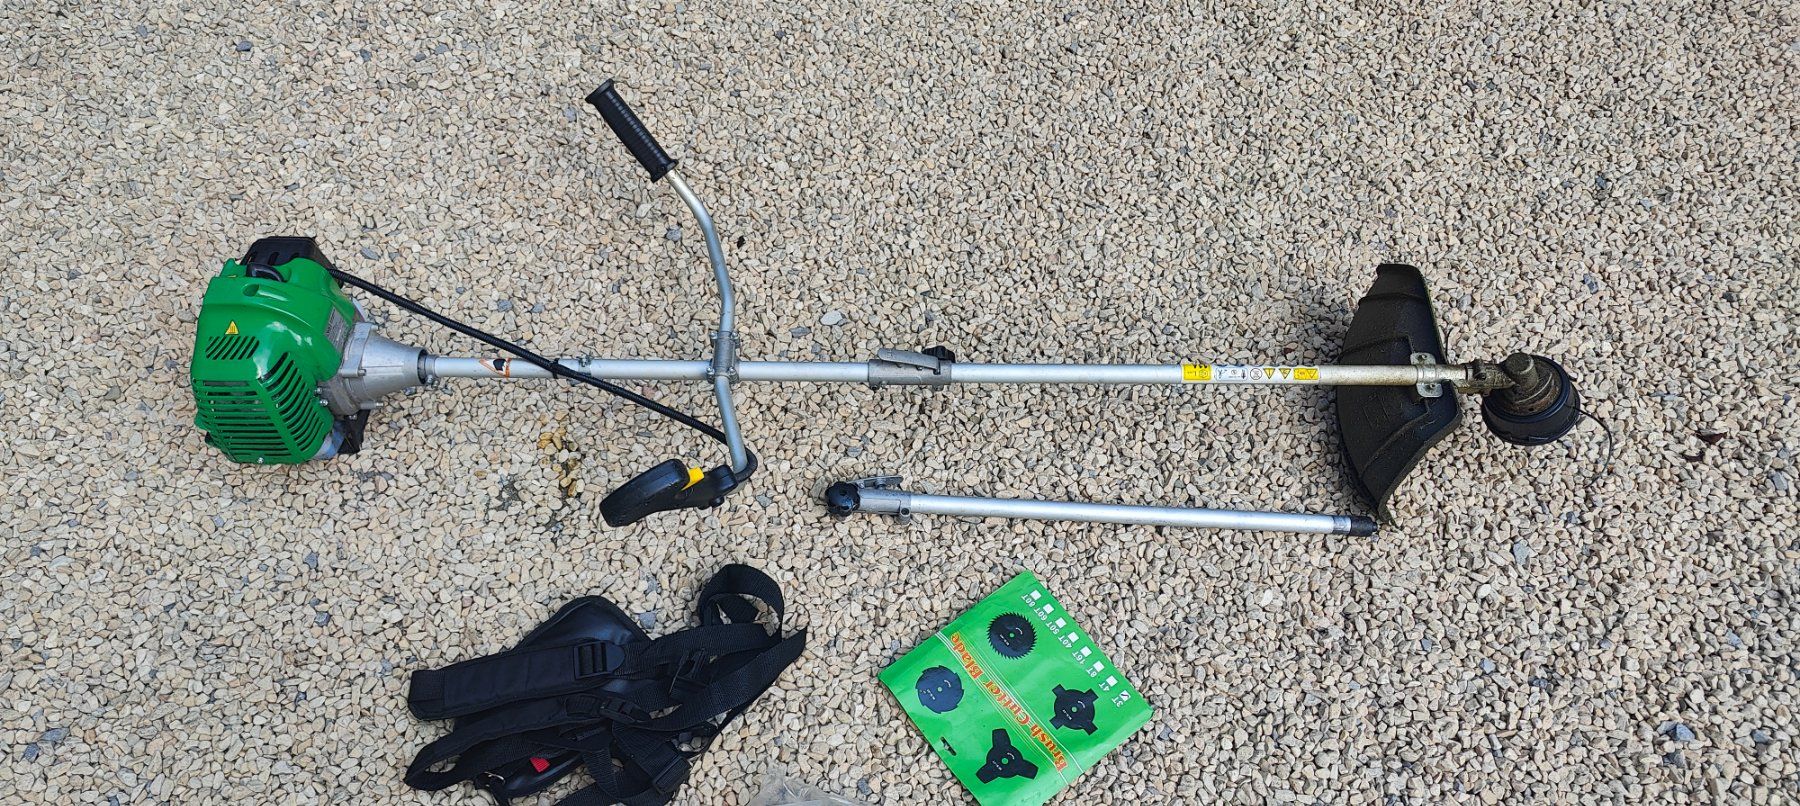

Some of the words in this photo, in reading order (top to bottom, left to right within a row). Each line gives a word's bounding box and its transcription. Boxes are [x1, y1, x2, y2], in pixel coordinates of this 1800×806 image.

[1034, 607, 1048, 621] 60T
[1045, 621, 1060, 635] 50T
[1058, 635, 1073, 649] 40T
[950, 631, 984, 680] Blade
[1072, 649, 1086, 665] 16T
[1086, 666, 1098, 678] 8T
[1099, 680, 1110, 692] 4T
[983, 679, 1031, 725] Cutter
[1112, 696, 1124, 708] 3T
[1030, 724, 1068, 772] Brush
